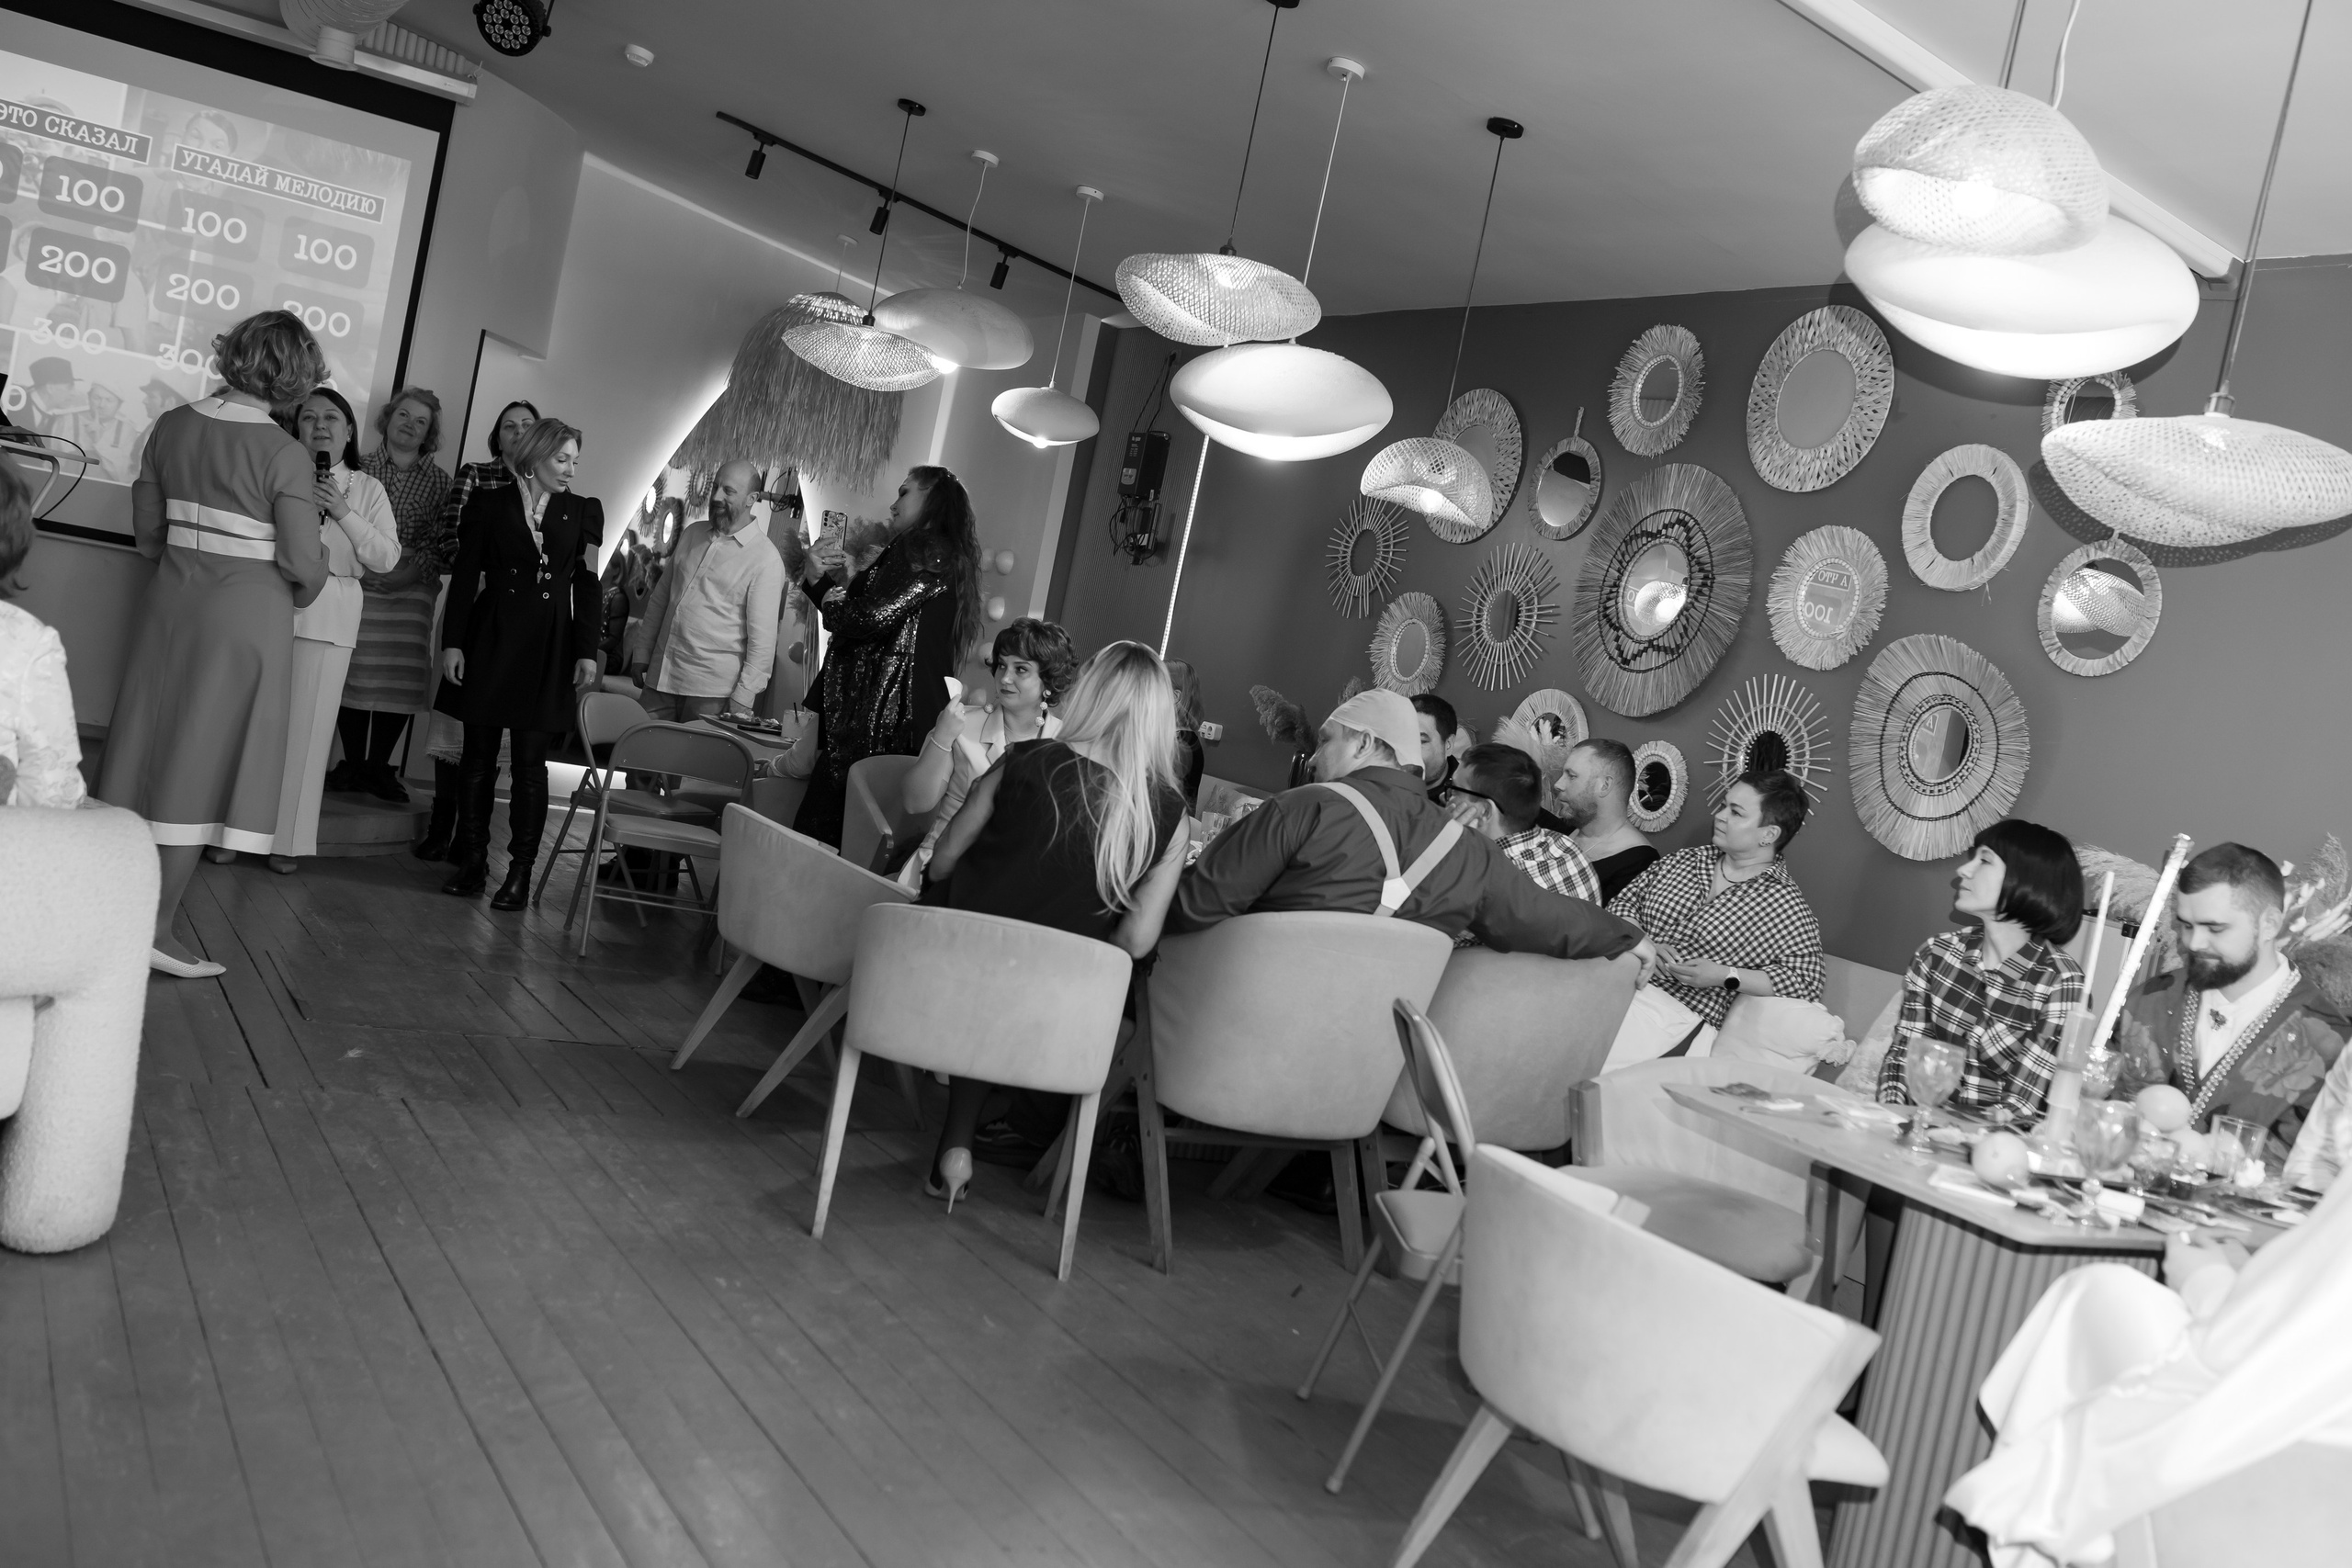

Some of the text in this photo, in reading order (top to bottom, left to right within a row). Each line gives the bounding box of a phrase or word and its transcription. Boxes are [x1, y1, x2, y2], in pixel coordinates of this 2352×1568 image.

[0, 102, 139, 154] ЭТО СКАЗАЛ
[55, 175, 125, 213] 100
[181, 149, 377, 215] УГАДАЙ МЕЛОДИЮ
[181, 207, 247, 243] 100
[38, 244, 116, 284] 200
[294, 233, 357, 271] 100
[165, 273, 241, 310] 200
[29, 317, 107, 355] 300
